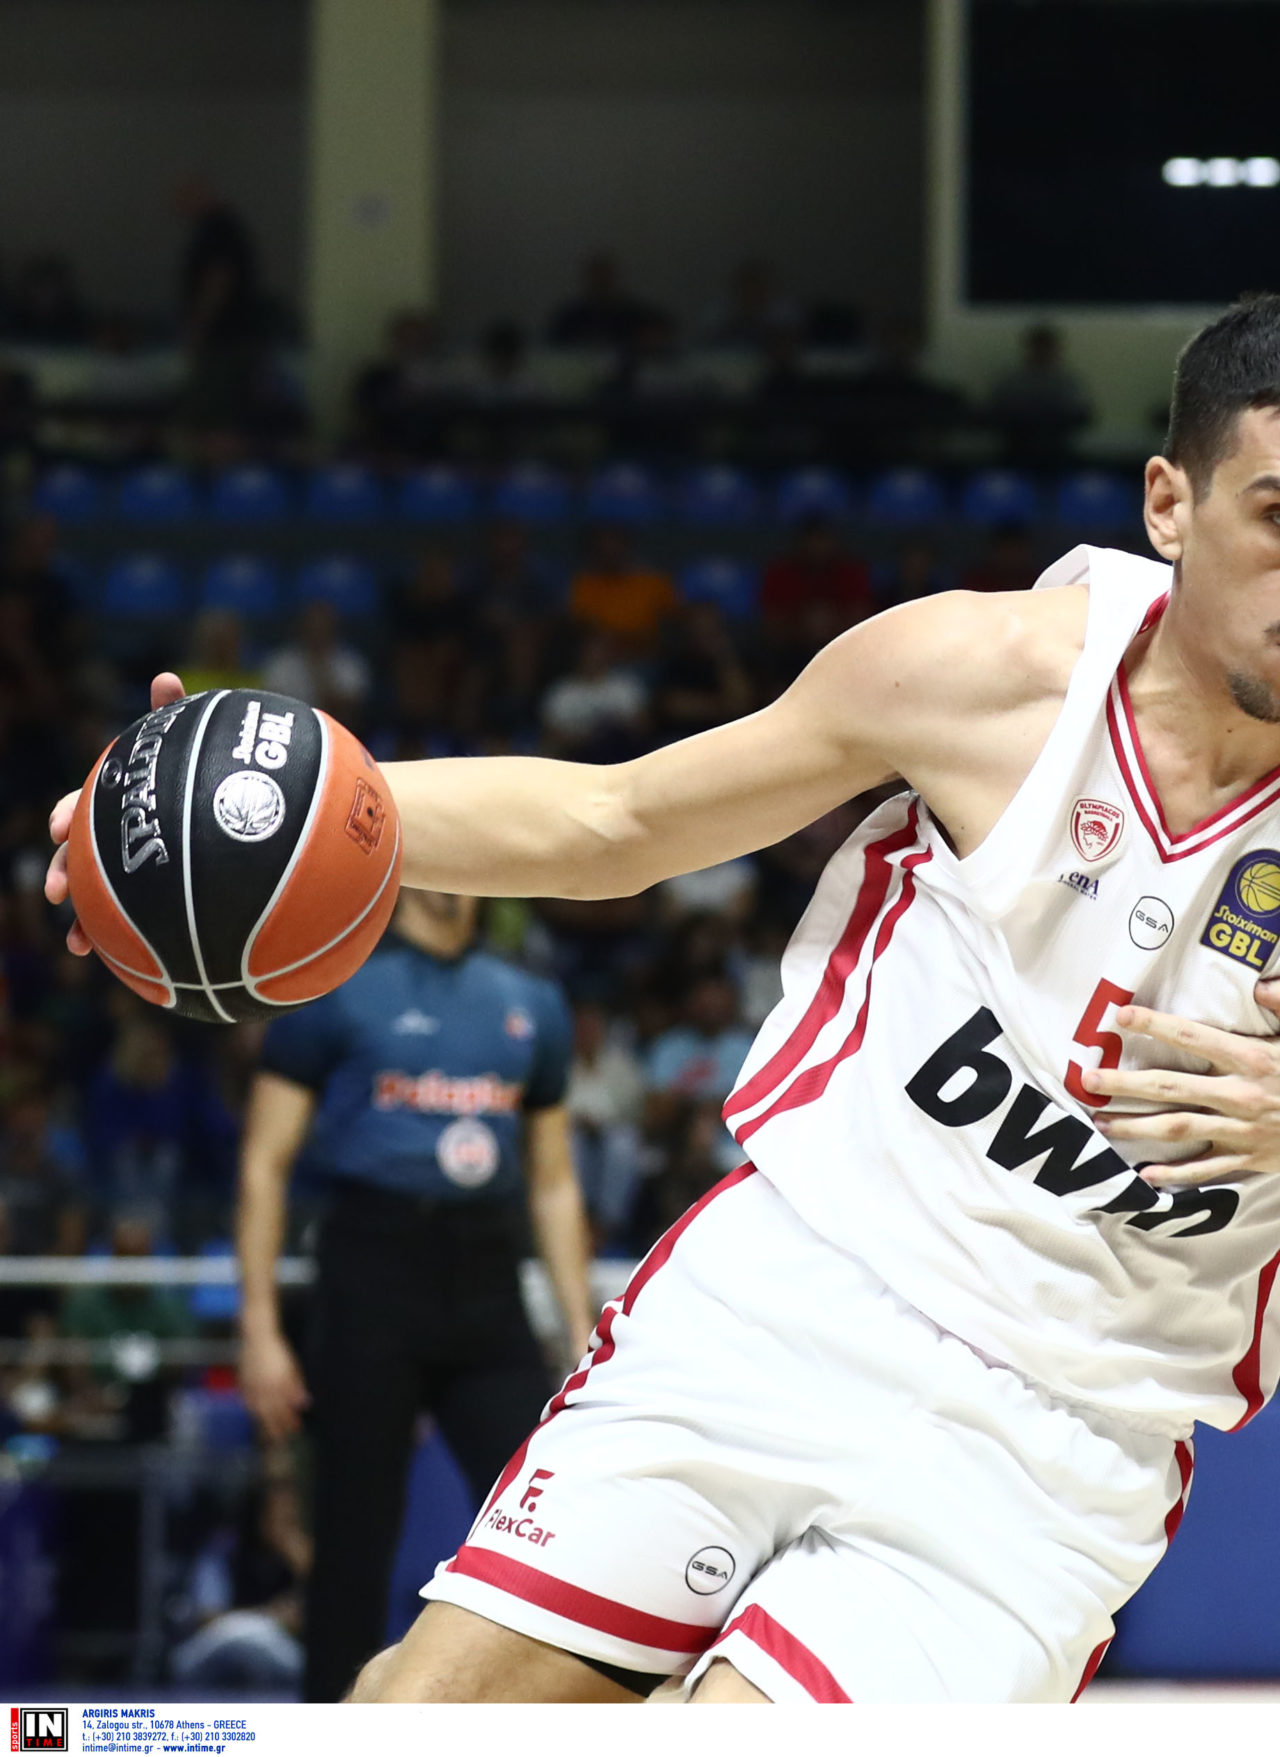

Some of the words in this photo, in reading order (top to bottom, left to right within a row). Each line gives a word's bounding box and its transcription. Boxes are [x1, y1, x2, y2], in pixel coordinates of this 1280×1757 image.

[255, 711, 295, 770] GBL
[1135, 909, 1169, 933] GSA
[1214, 905, 1278, 943] Stoiximan
[1209, 922, 1264, 967] GBL
[1063, 977, 1136, 1108] 5
[691, 1560, 728, 1580] GSA
